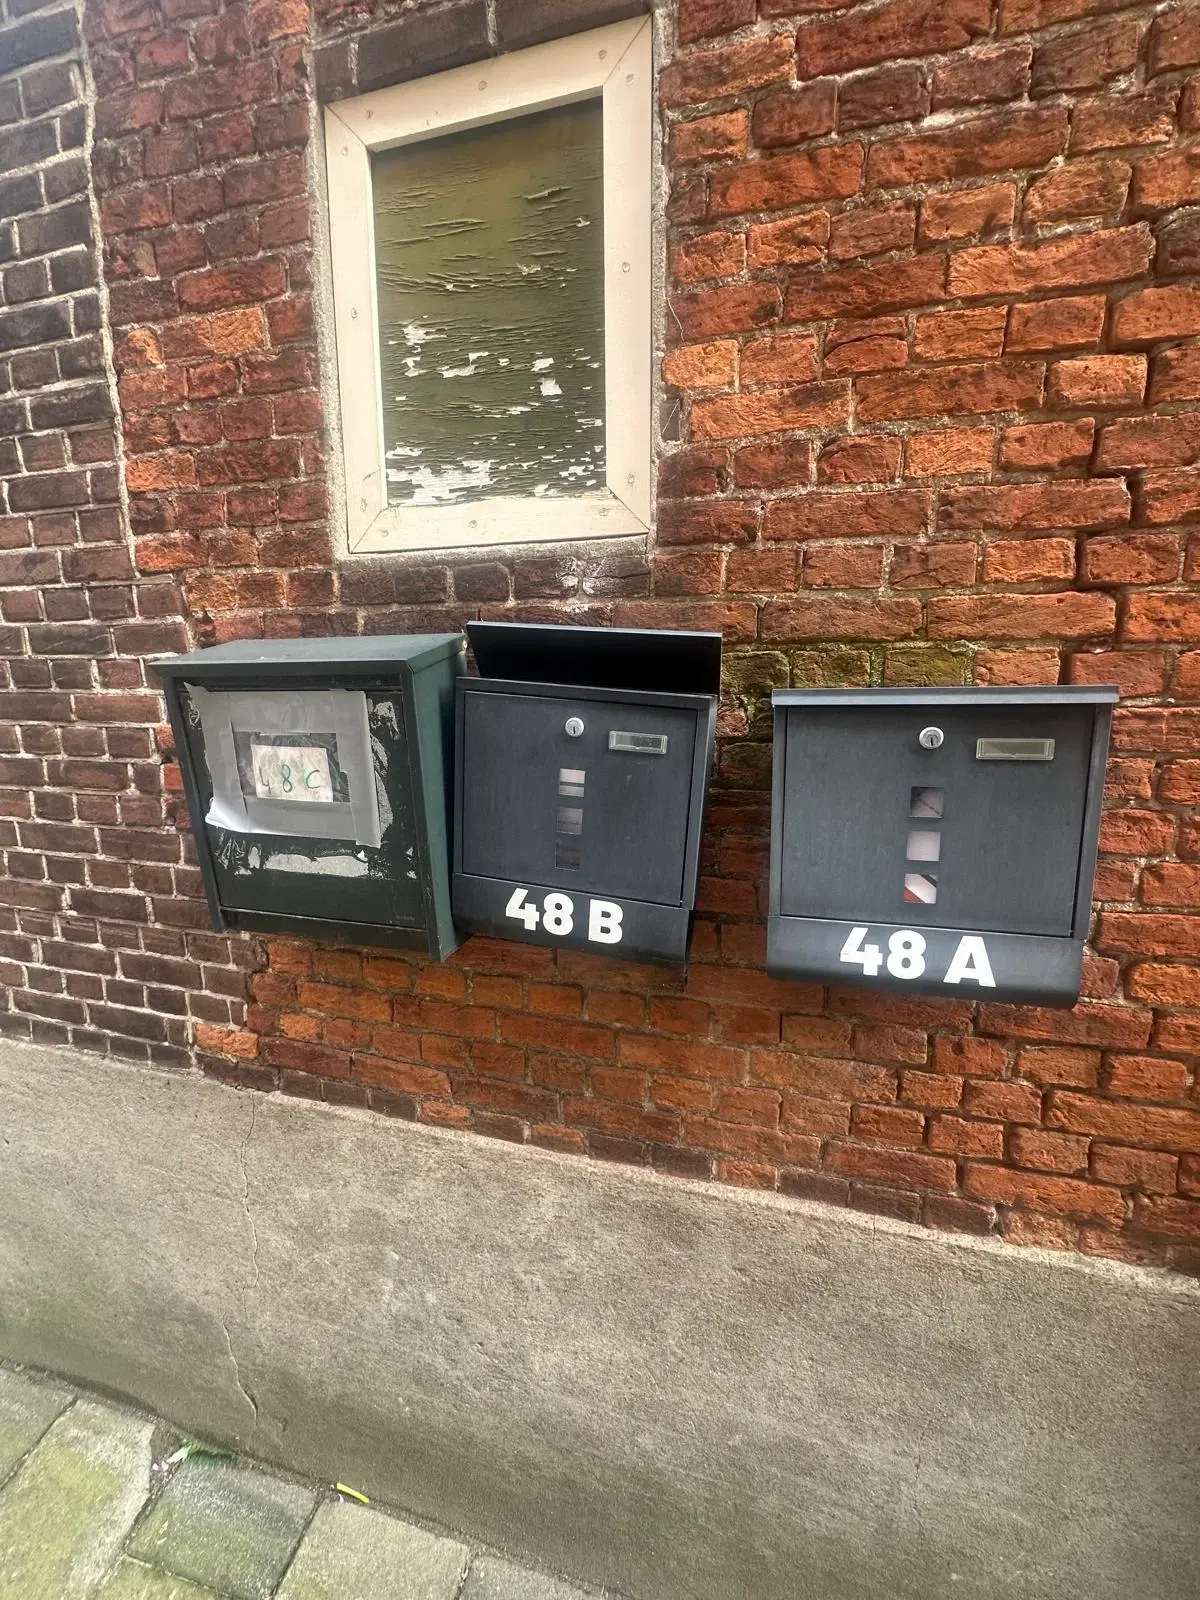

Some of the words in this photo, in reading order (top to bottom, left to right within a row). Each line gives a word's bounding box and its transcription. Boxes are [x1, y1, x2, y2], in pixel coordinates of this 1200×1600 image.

[506, 887, 574, 936] 48
[588, 899, 624, 944] B
[840, 927, 927, 980] 48
[943, 935, 997, 988] A
